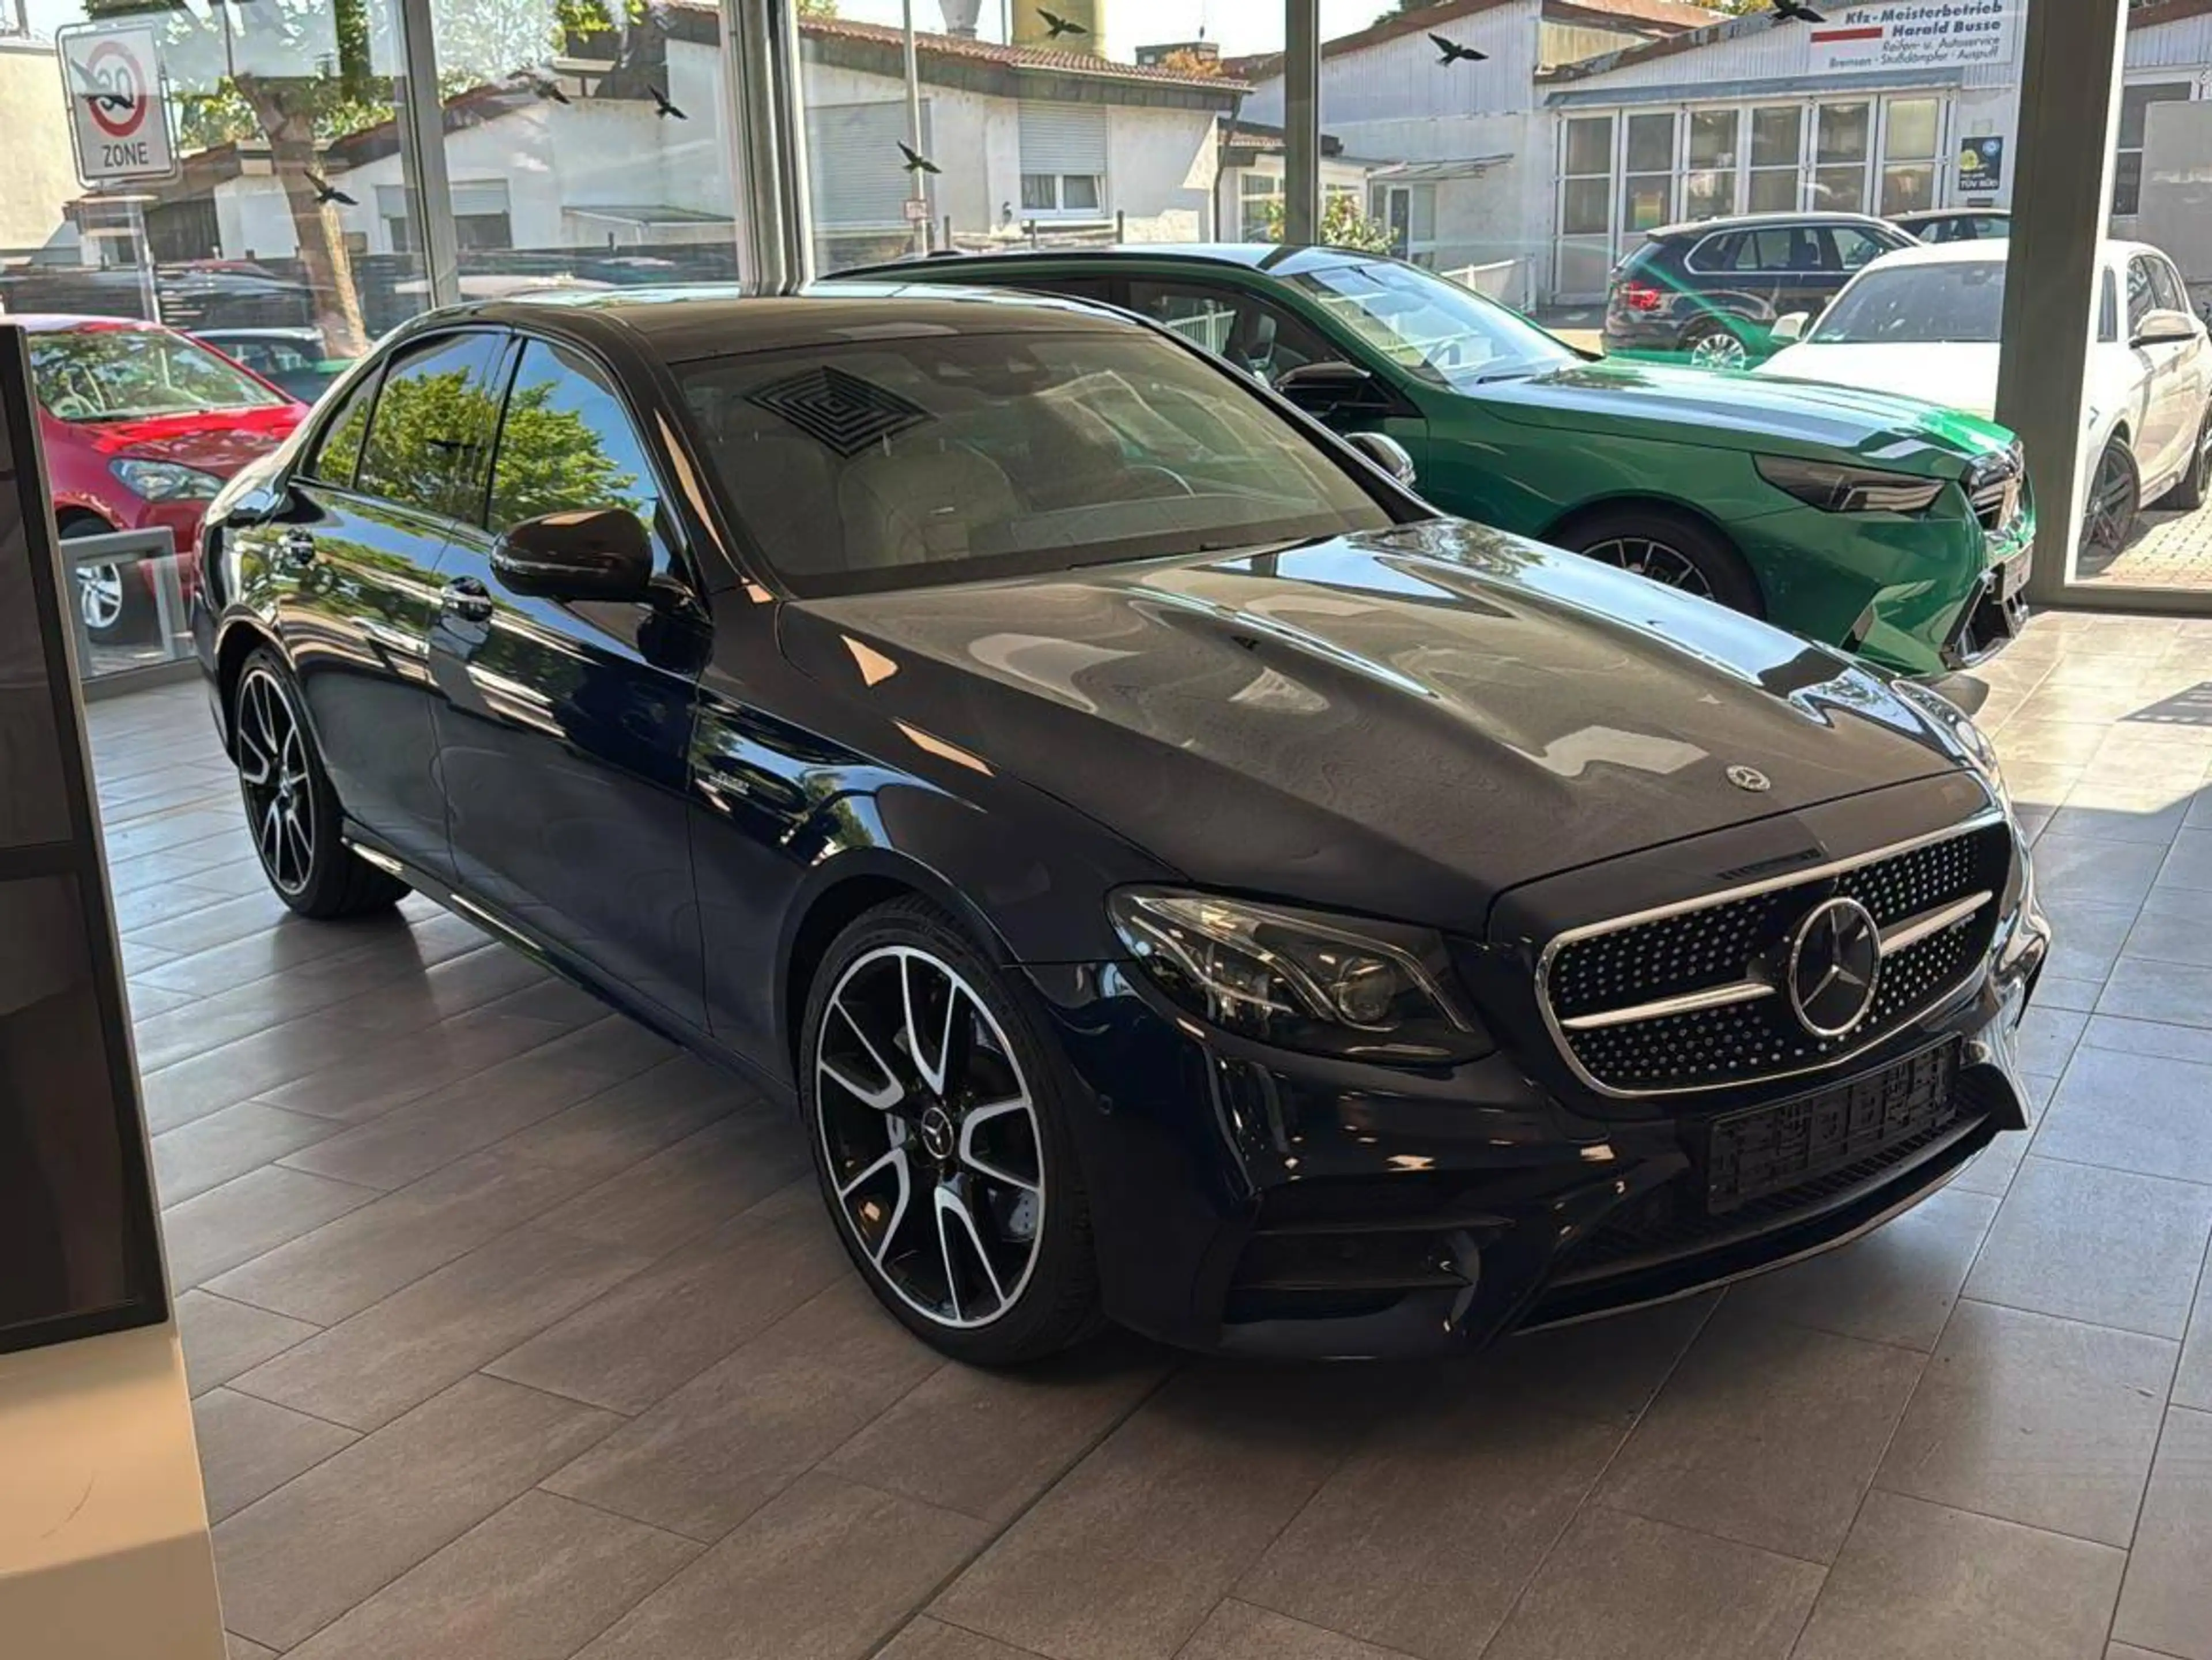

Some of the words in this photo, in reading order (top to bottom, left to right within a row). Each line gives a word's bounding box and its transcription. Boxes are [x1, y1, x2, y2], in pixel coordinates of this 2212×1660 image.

[1845, 1, 2003, 25] Kfz-Meisterbetrieb
[1893, 20, 1947, 37] Harald
[1953, 20, 2000, 33] Busse
[1939, 36, 2000, 48] Autoservice
[1829, 56, 1871, 68] Bremsen
[1957, 46, 1999, 61] Auspuff
[101, 142, 149, 168] ZONE
